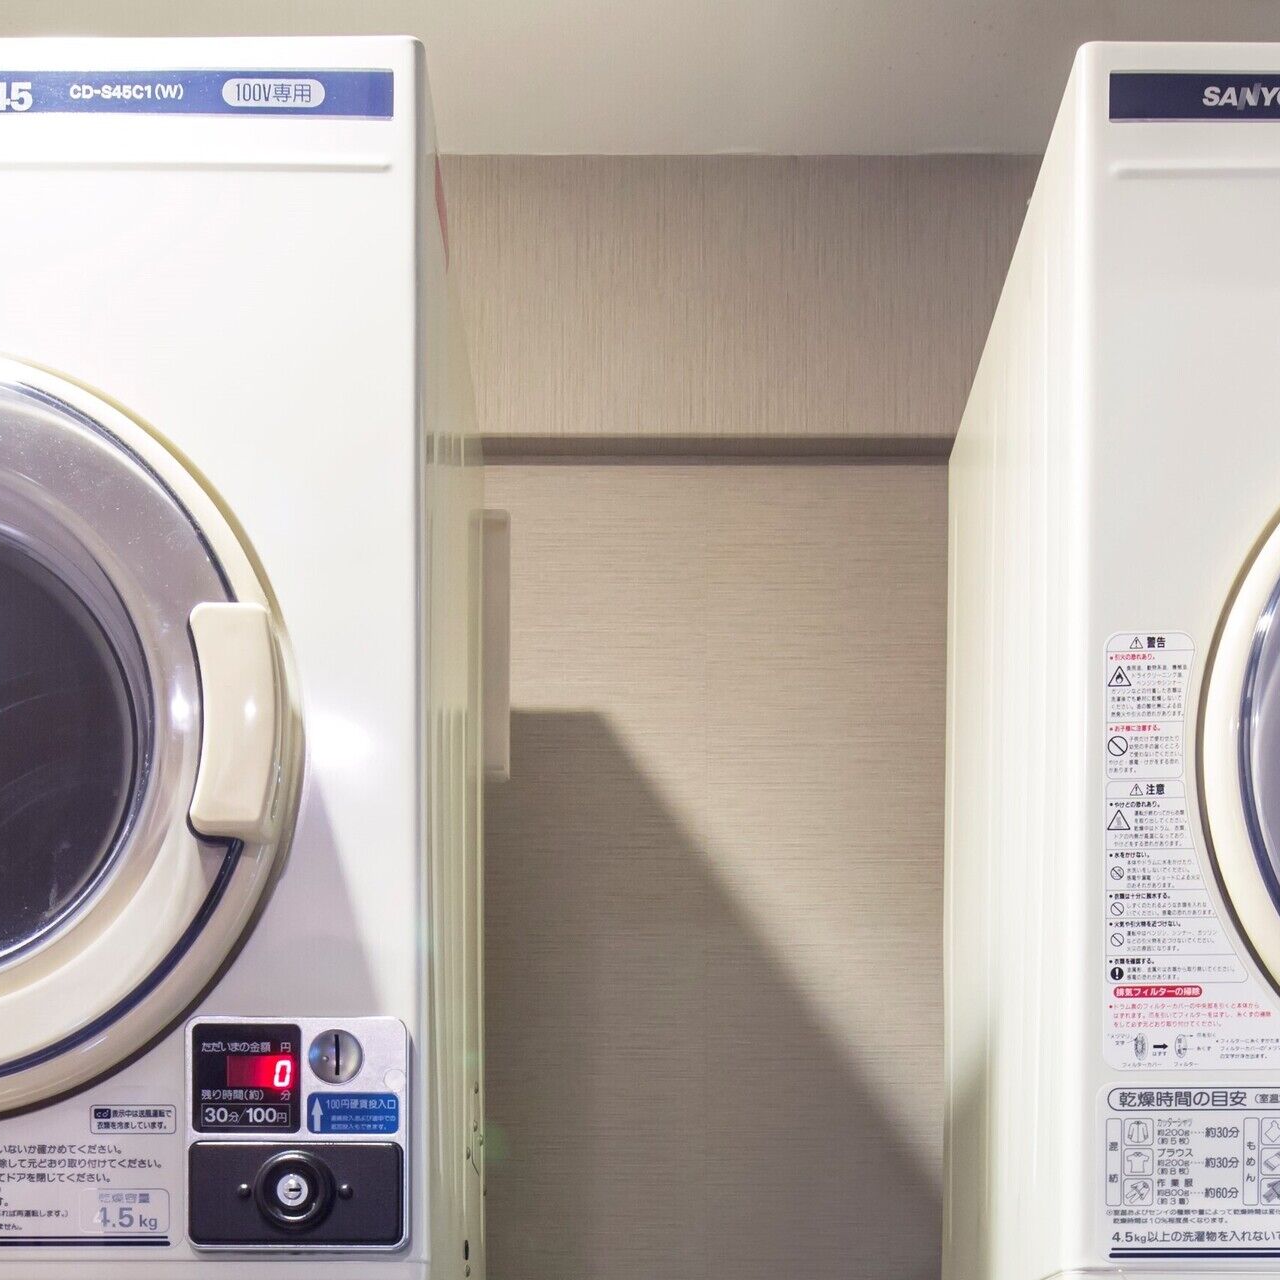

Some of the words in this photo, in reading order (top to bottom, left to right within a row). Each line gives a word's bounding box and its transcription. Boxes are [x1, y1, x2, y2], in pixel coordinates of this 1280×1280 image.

[69, 83, 184, 100] CD-S45C1(W)
[235, 82, 312, 103] 100V専用
[1147, 637, 1165, 649] 警告
[1146, 784, 1165, 795] 注意
[201, 1042, 271, 1052] ただいまの金額
[281, 1042, 291, 1052] 円
[274, 1060, 291, 1087] 0
[201, 1090, 264, 1100] 残り時間(約)
[281, 1092, 291, 1101] 分
[1119, 1091, 1247, 1107] 乾燥時間の目安
[1205, 1127, 1239, 1138] 約30分
[1205, 1157, 1239, 1169] 約30分
[1205, 1187, 1239, 1199] 約60分
[139, 1215, 157, 1230] kg
